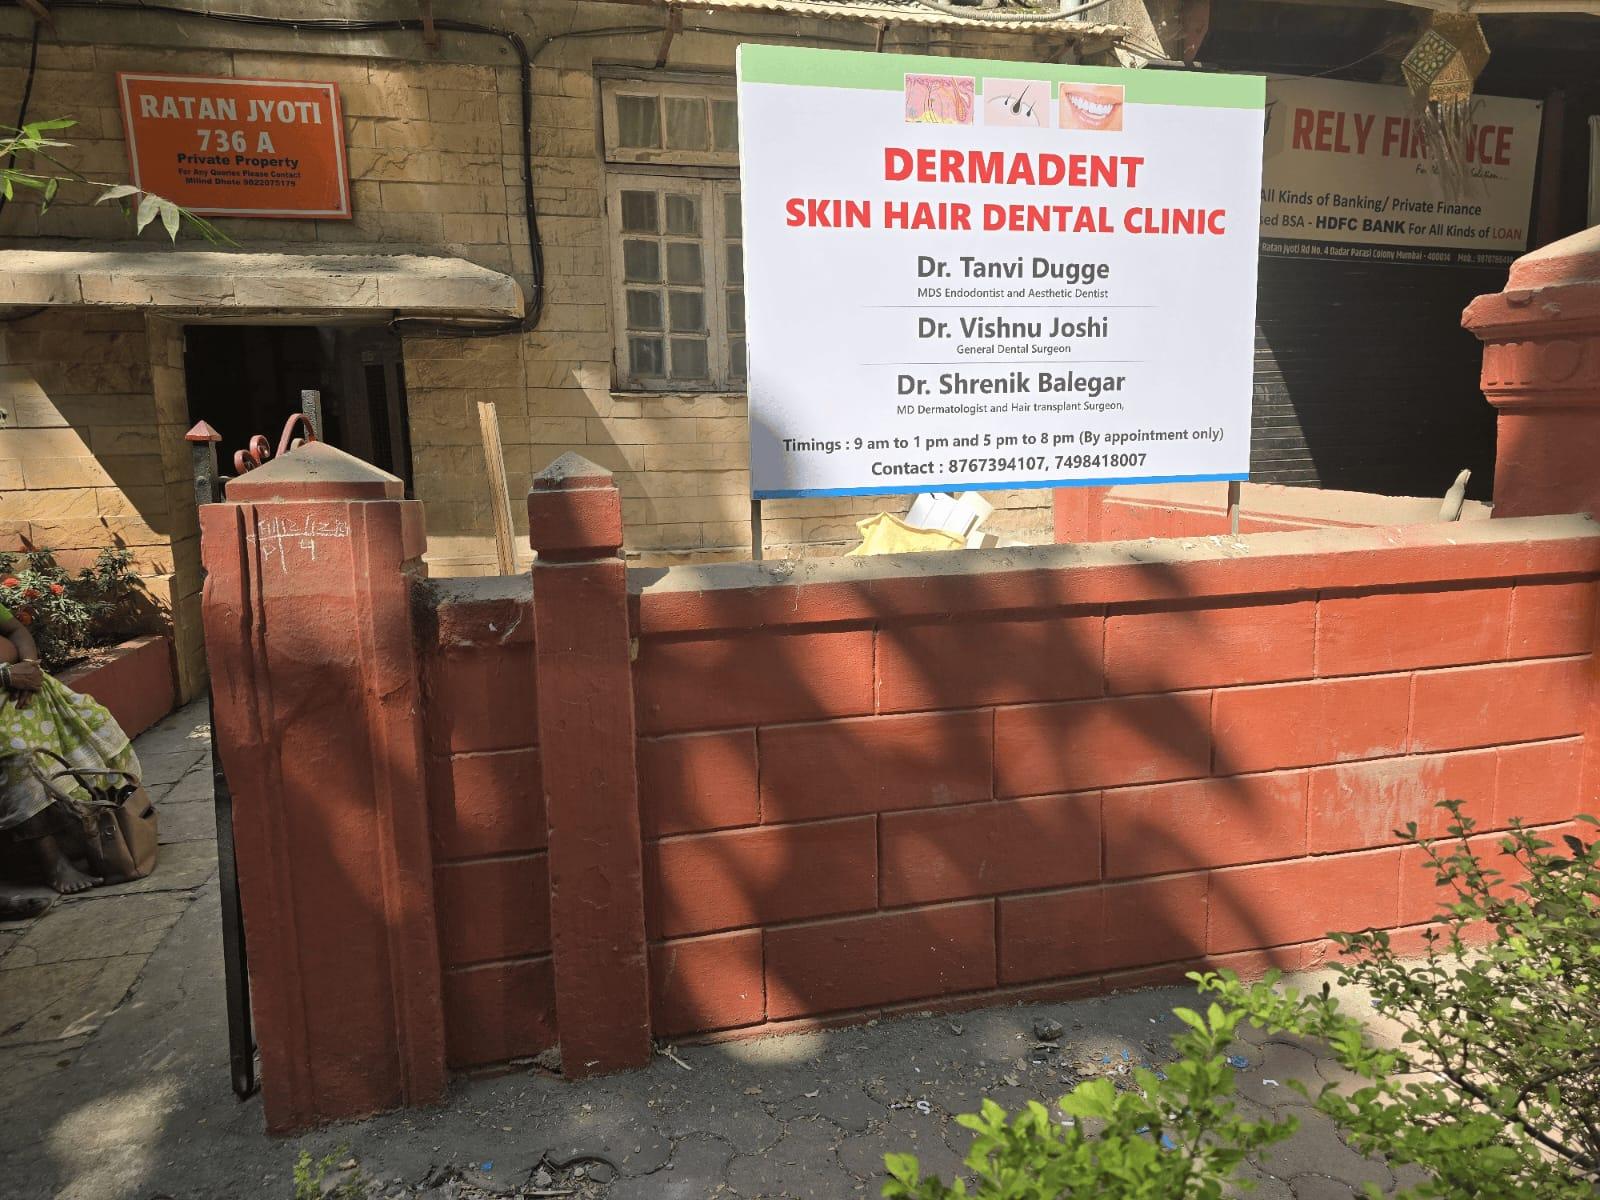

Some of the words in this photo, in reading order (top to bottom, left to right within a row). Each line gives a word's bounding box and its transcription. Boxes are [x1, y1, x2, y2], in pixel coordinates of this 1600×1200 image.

[140, 94, 238, 121] RATAN
[247, 100, 322, 125] JYOTI
[197, 129, 247, 153] 736
[257, 132, 276, 154] A
[1292, 107, 1376, 155] RELY
[1382, 116, 1514, 166] FINNCE
[177, 153, 230, 166] Private
[236, 155, 299, 169] Property
[885, 147, 1145, 188] DERMADENT
[1260, 189, 1275, 203] All
[1279, 190, 1313, 205] Kinds
[1316, 193, 1331, 206] of
[1333, 194, 1390, 213] Banking/
[1392, 198, 1434, 213] Private
[1437, 201, 1482, 216] Finance
[786, 198, 871, 228] SKIN
[884, 202, 972, 231] HAIR
[983, 204, 1115, 233] DENTAL
[1123, 206, 1226, 235] CLINIC
[1281, 215, 1305, 228] BSA
[1316, 216, 1358, 231] HDFC
[1362, 218, 1406, 234] BANK
[1409, 222, 1427, 235] For
[1429, 223, 1444, 236] All
[1446, 225, 1476, 238] Kinds
[1478, 226, 1491, 239] of
[1492, 227, 1523, 240] LOAN
[918, 256, 951, 278] Dr.
[960, 256, 1023, 279] Tanvi
[1032, 257, 1110, 285] Dugge
[917, 288, 942, 298] MDS
[945, 287, 1005, 298] Endodontist
[1007, 288, 1026, 298] and
[1028, 288, 1072, 298] Aesthetic
[1075, 288, 1109, 298] Dentist
[919, 317, 951, 338] Dr.
[960, 316, 1042, 338] Vishnu
[1050, 316, 1108, 338] Joshi
[957, 345, 995, 354] General
[998, 344, 1029, 354] Dental
[1032, 345, 1071, 355] Surgeon
[898, 374, 931, 395] Dr.
[939, 371, 1031, 395] Shrenik
[1038, 370, 1126, 398] Balegar
[897, 405, 915, 415] MD
[917, 403, 988, 416] Dermatologist
[990, 403, 1008, 413] and
[1011, 402, 1031, 412] Hair
[1033, 402, 1082, 414] transplant
[1083, 401, 1125, 413] Surgeon,
[783, 438, 842, 454] Timings
[854, 437, 863, 450] 9
[867, 440, 890, 450] am
[894, 438, 909, 449] to
[913, 436, 920, 448] 1
[926, 438, 949, 451] pm
[952, 434, 979, 447] and
[983, 435, 991, 447] 5
[996, 435, 1018, 449] pm
[1022, 433, 1036, 445] to
[1040, 432, 1049, 444] 8
[1053, 434, 1074, 447] pm
[1079, 430, 1100, 446] (By
[1104, 429, 1189, 446] appointment
[1192, 427, 1225, 442] only)
[871, 460, 934, 476] Contact
[948, 456, 1050, 473] 8767394107,
[1054, 453, 1147, 470] 7498418007
